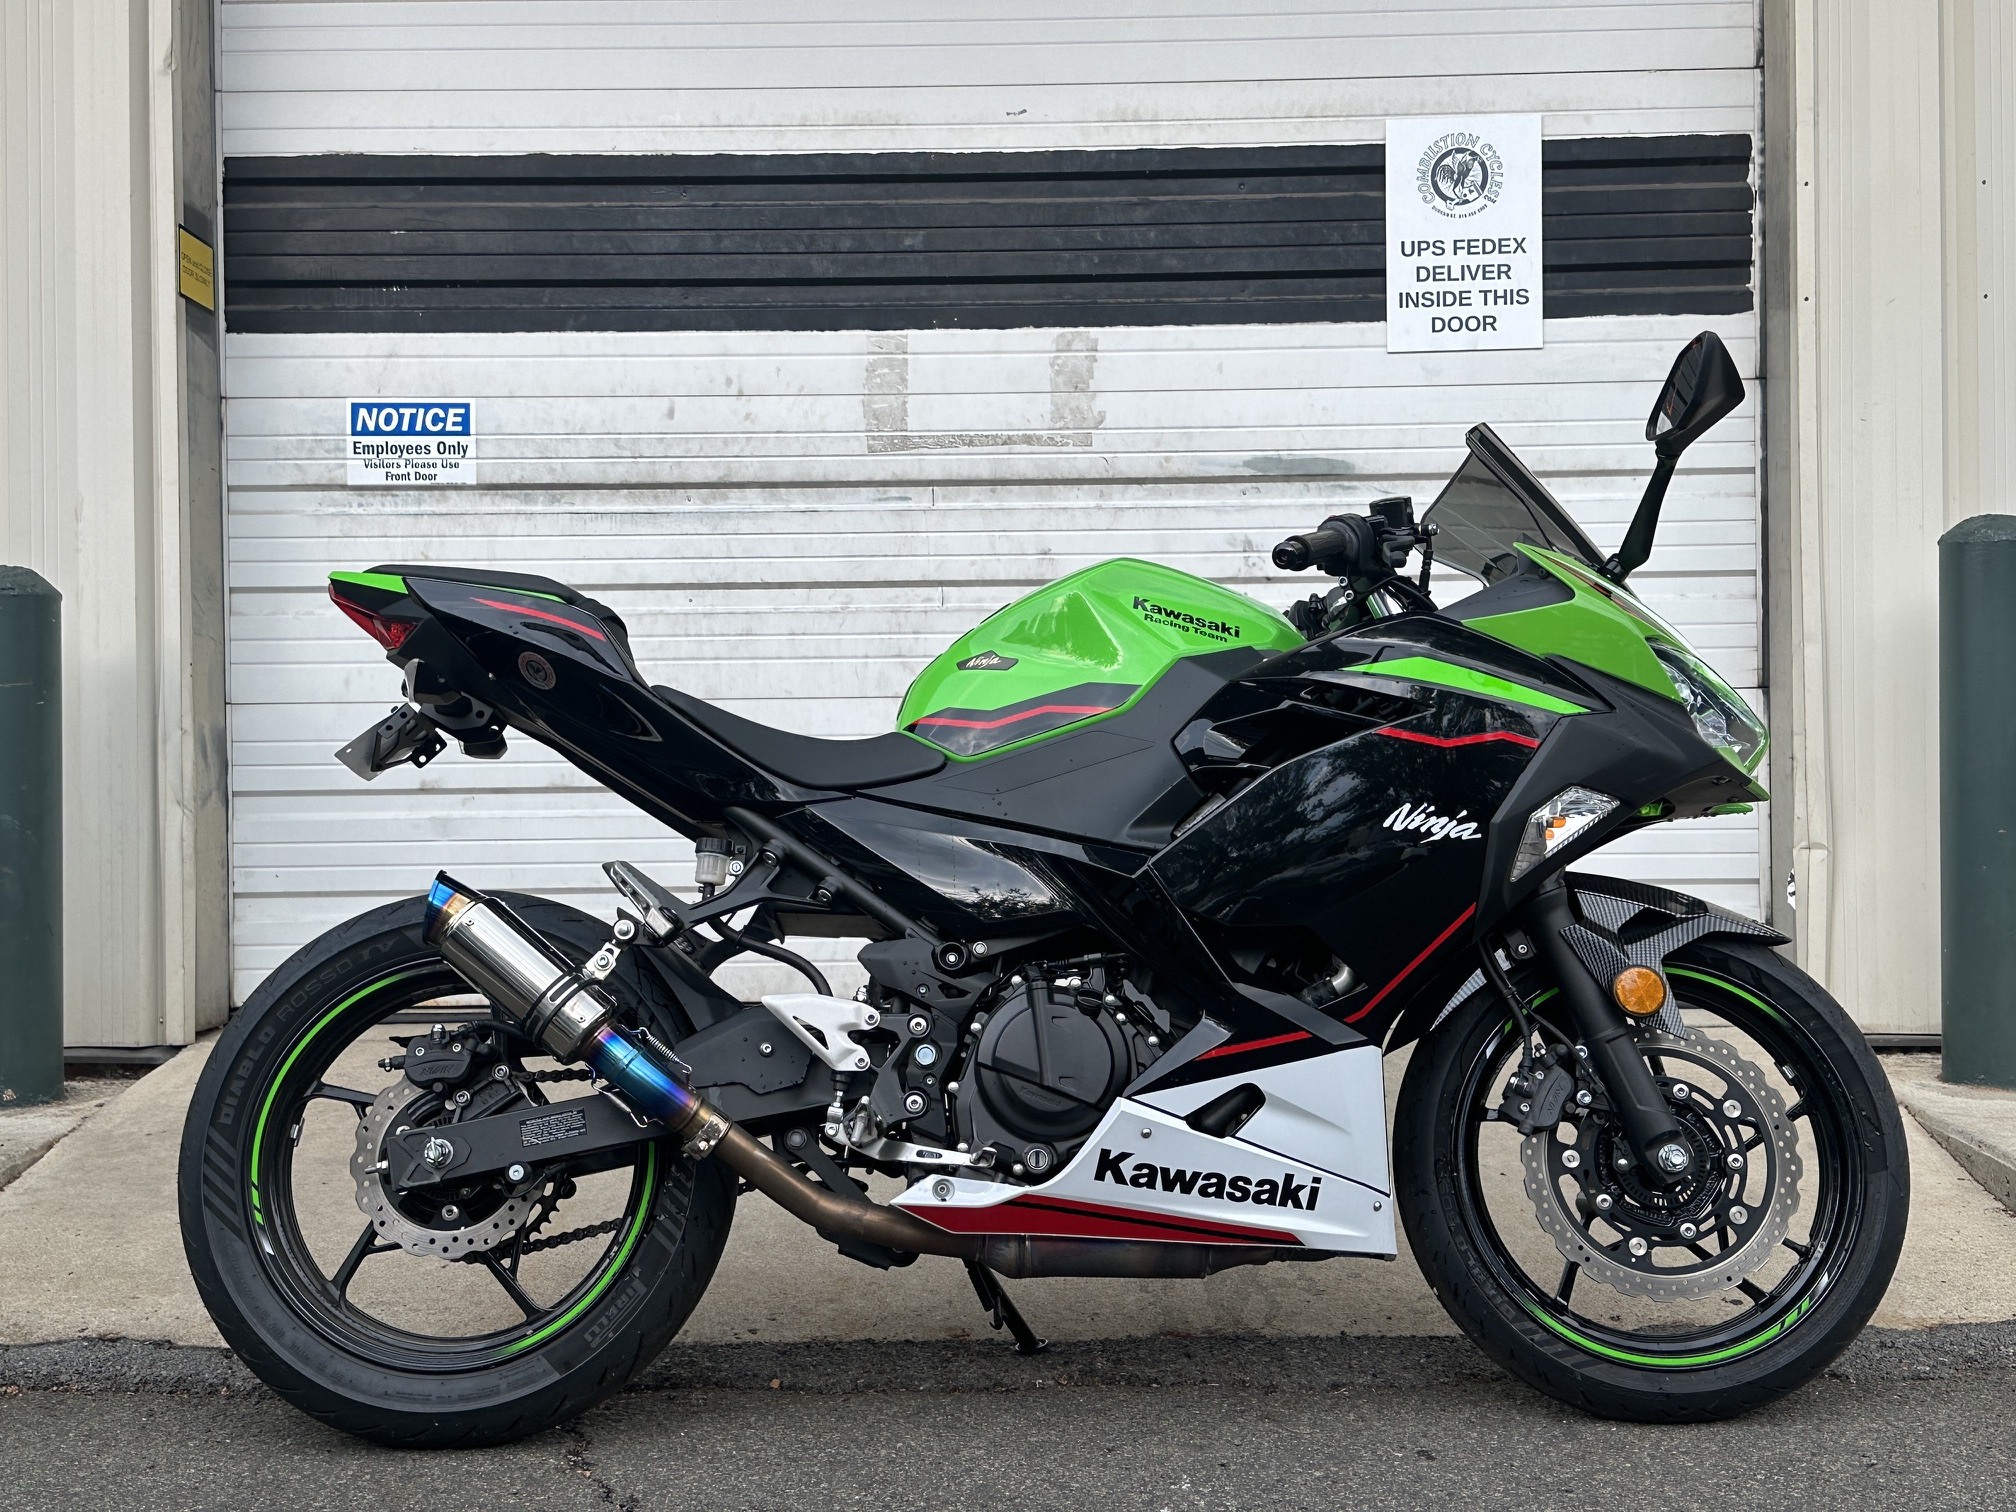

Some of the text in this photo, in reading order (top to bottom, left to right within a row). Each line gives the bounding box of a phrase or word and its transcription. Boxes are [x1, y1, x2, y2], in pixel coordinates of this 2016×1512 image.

[1416, 132, 1503, 204] COMBUSTION CYCLES
[1400, 237, 1527, 257] UPS FEDEX
[1416, 264, 1512, 282] DELIVER
[1398, 288, 1530, 309] INSIDE THIS
[1431, 315, 1497, 333] DOOR
[356, 407, 466, 432] NOTICE
[353, 441, 469, 458] Employees Only
[364, 459, 460, 469] Visitors Please Use
[385, 471, 438, 481] Front Door
[1132, 595, 1240, 639] Kawasaki
[1144, 613, 1228, 643] Racing Team
[965, 654, 1002, 668] Ninja
[1382, 801, 1482, 844] Ninja
[217, 1026, 276, 1125] DIABLO
[276, 960, 353, 1023] ROSSO
[1093, 1147, 1323, 1211] Kawasaki
